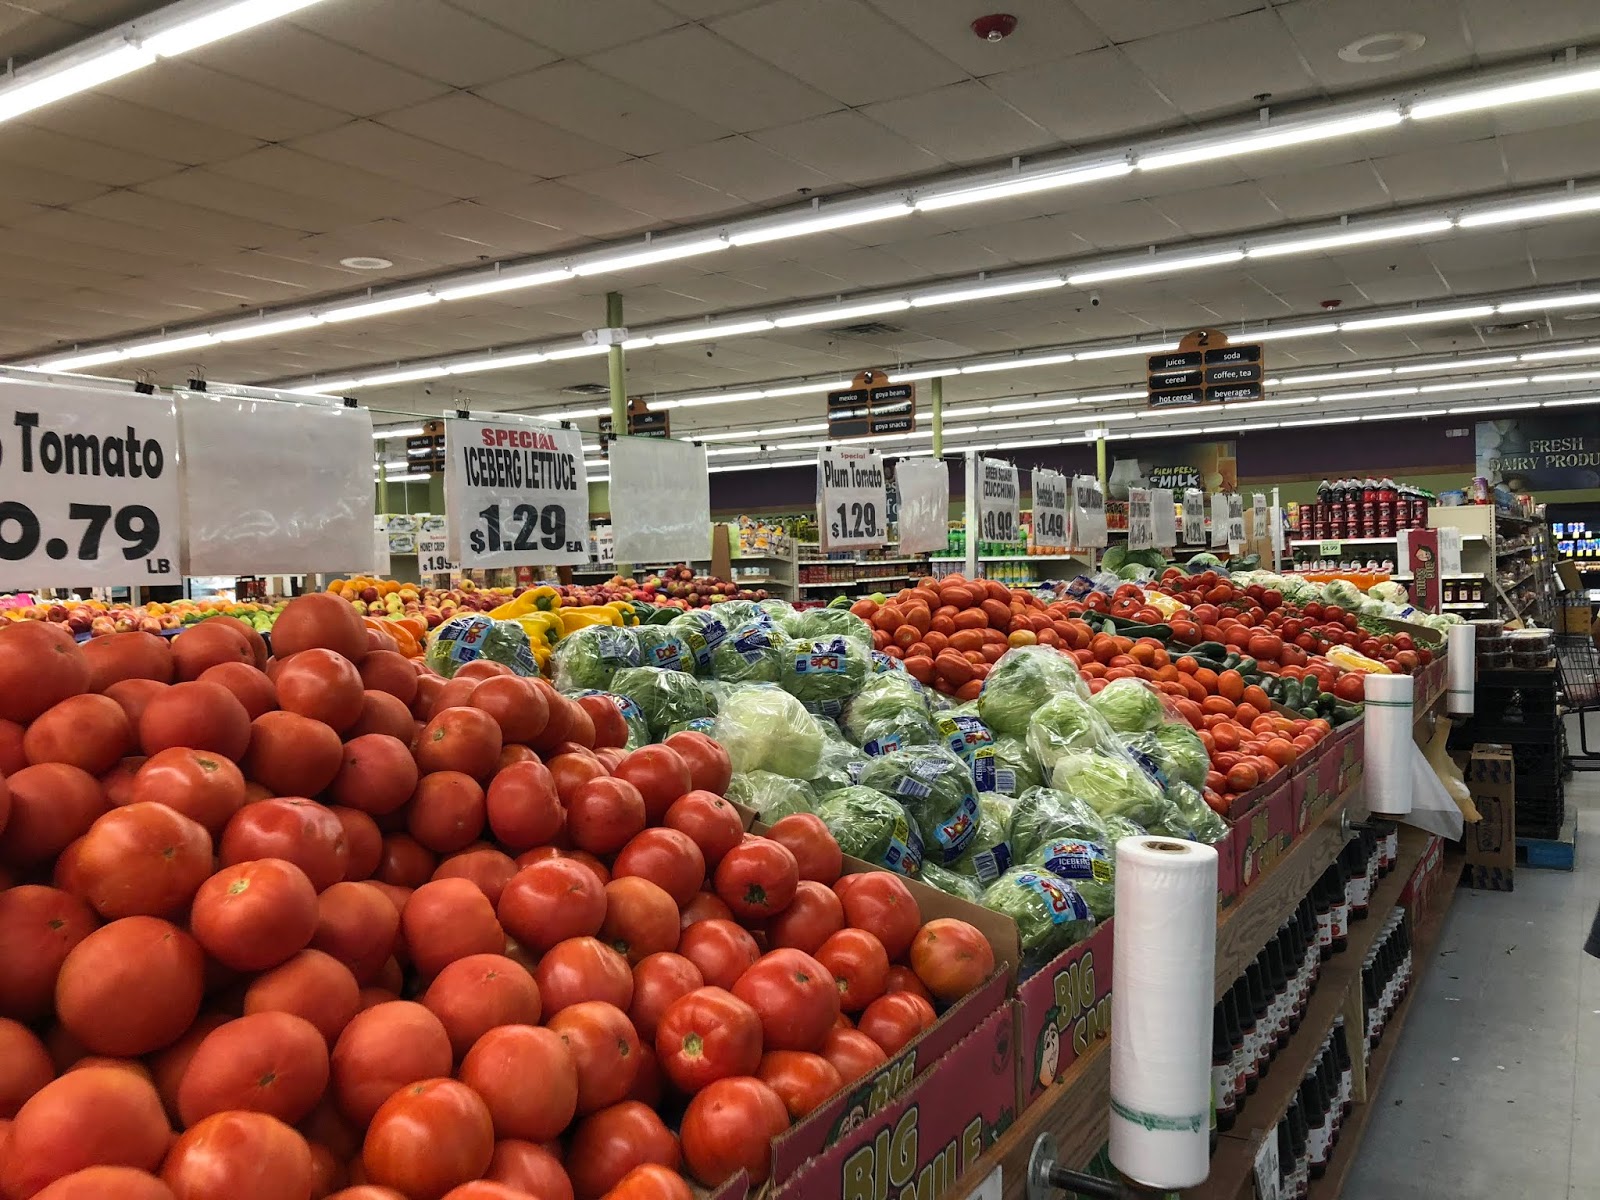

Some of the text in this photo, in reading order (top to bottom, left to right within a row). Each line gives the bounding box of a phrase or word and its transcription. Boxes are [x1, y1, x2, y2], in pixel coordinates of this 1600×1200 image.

[1197, 331, 1209, 346] 2
[1165, 358, 1186, 367] juices
[1223, 352, 1241, 360] soda
[1165, 376, 1187, 384] cereal
[1213, 371, 1238, 379] coffee,
[838, 394, 858, 402] mexico
[875, 389, 906, 400] goya beans
[1172, 393, 1194, 402] cereal
[1214, 388, 1251, 398] beverages
[875, 423, 888, 431] goya
[15, 411, 164, 479] Tomato
[481, 428, 558, 450] SPECIAL
[1529, 436, 1584, 454] FRESH
[840, 452, 866, 460] Special
[1488, 456, 1540, 472] DAIRY
[463, 446, 577, 491] ICEBERG LETTUCE
[823, 460, 882, 489] Plum Tomato
[1158, 474, 1199, 488] MILK
[831, 502, 876, 539] $1.29
[469, 504, 584, 554] $1.29 EA
[420, 541, 445, 552] HONEY CRISP
[146, 558, 171, 575] LB
[1424, 561, 1435, 579] BIG
[464, 621, 489, 644] Dole
[655, 643, 677, 660] Dole
[810, 656, 839, 670] Dole
[965, 729, 993, 745] Dole
[943, 813, 970, 841] Dole
[901, 855, 920, 876] ole
[1059, 857, 1091, 866] ICEBERG
[1040, 879, 1068, 914] Dole
[1053, 951, 1096, 1033] BIG
[842, 1106, 919, 1200] BIG
